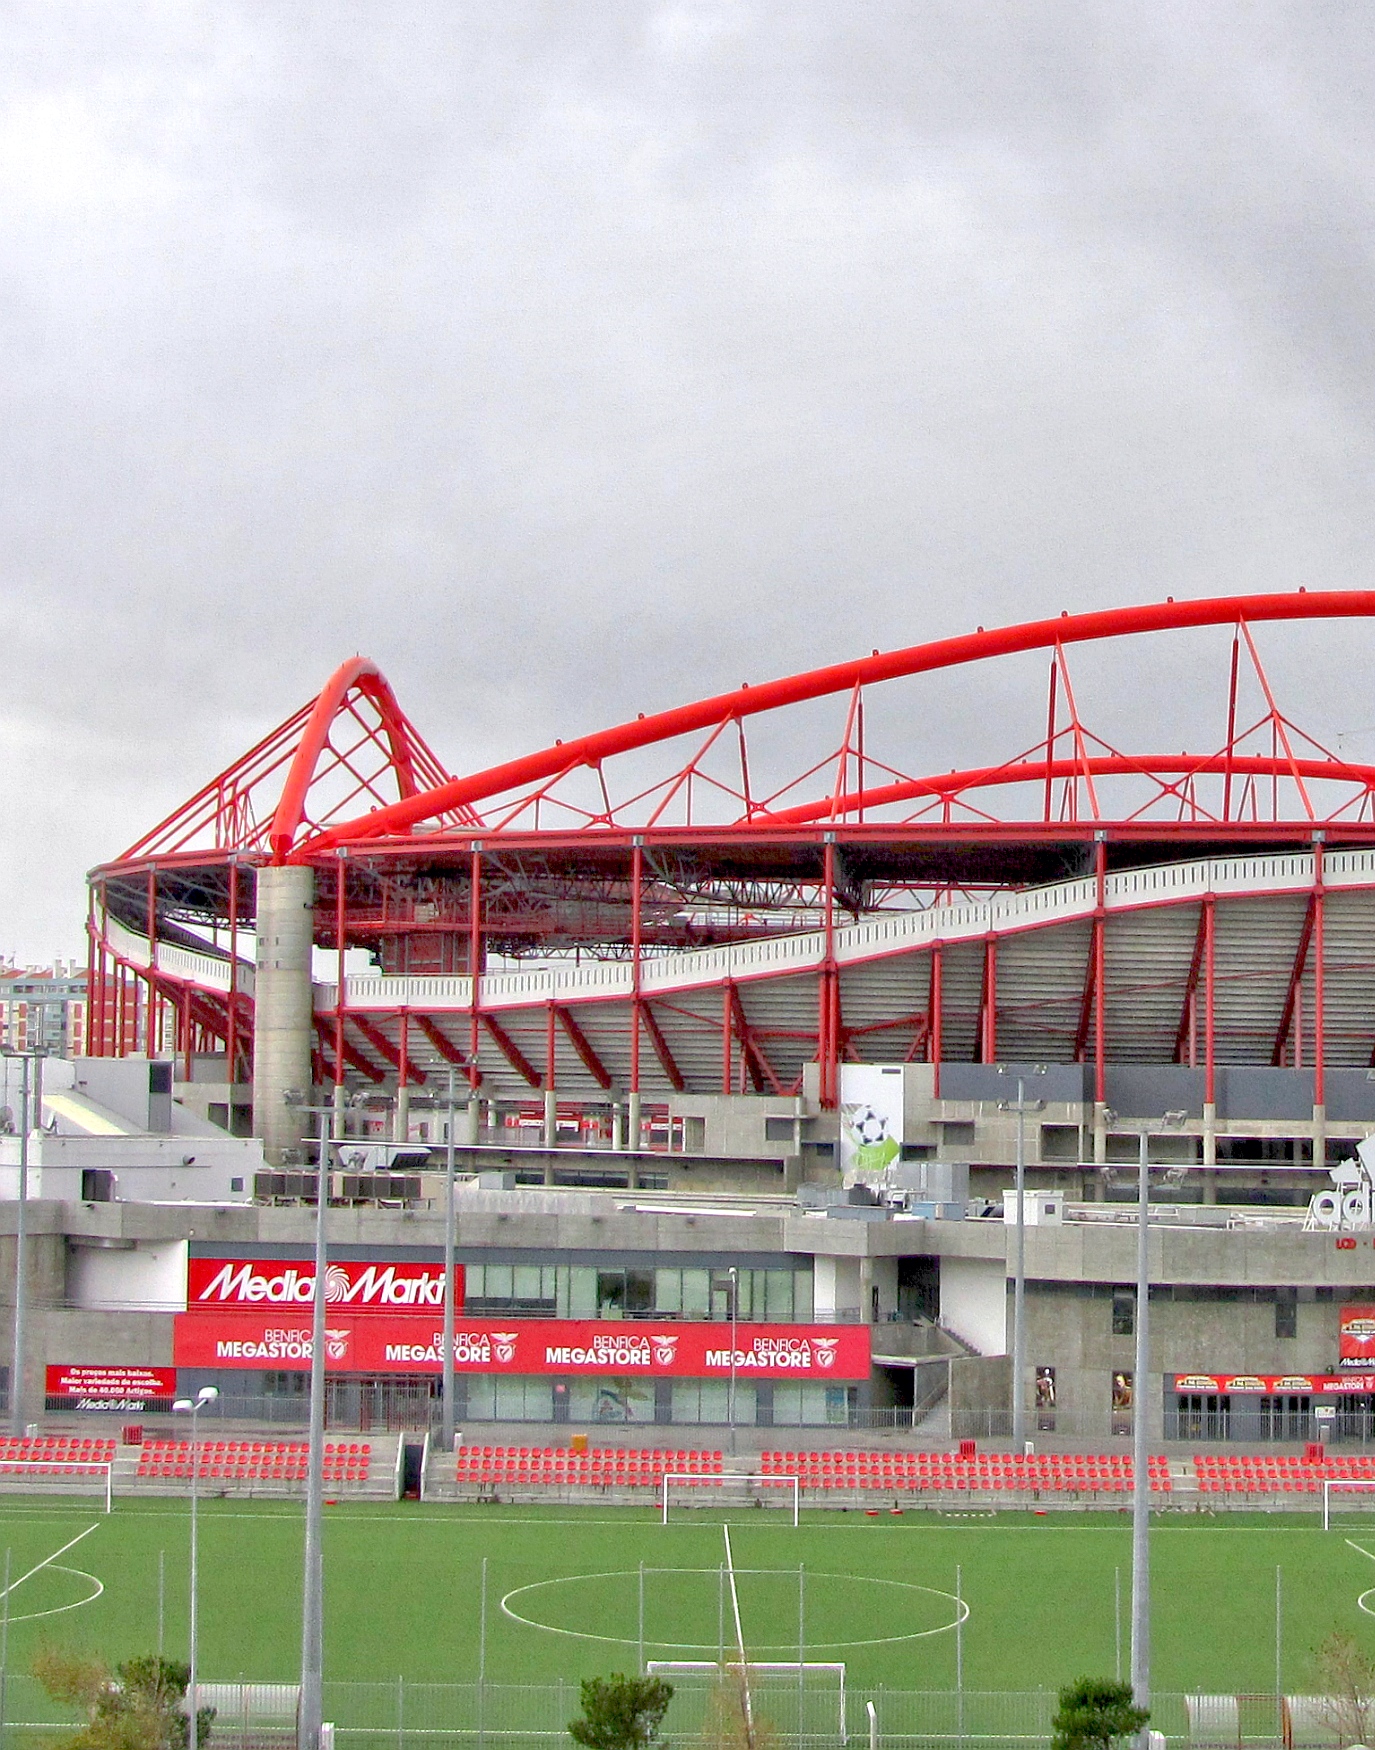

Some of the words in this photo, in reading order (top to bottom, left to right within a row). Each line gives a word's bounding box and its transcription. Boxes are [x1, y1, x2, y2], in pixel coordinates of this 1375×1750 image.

[200, 1263, 317, 1303] Media
[216, 1341, 313, 1359] MEGASTOR
[593, 1335, 650, 1349] BENFICA
[753, 1338, 811, 1352] BENFICA
[545, 1347, 651, 1366] MEGASTORE
[705, 1350, 811, 1368] MEGASTORE
[61, 1377, 82, 1385] Maior
[88, 1386, 98, 1394] de
